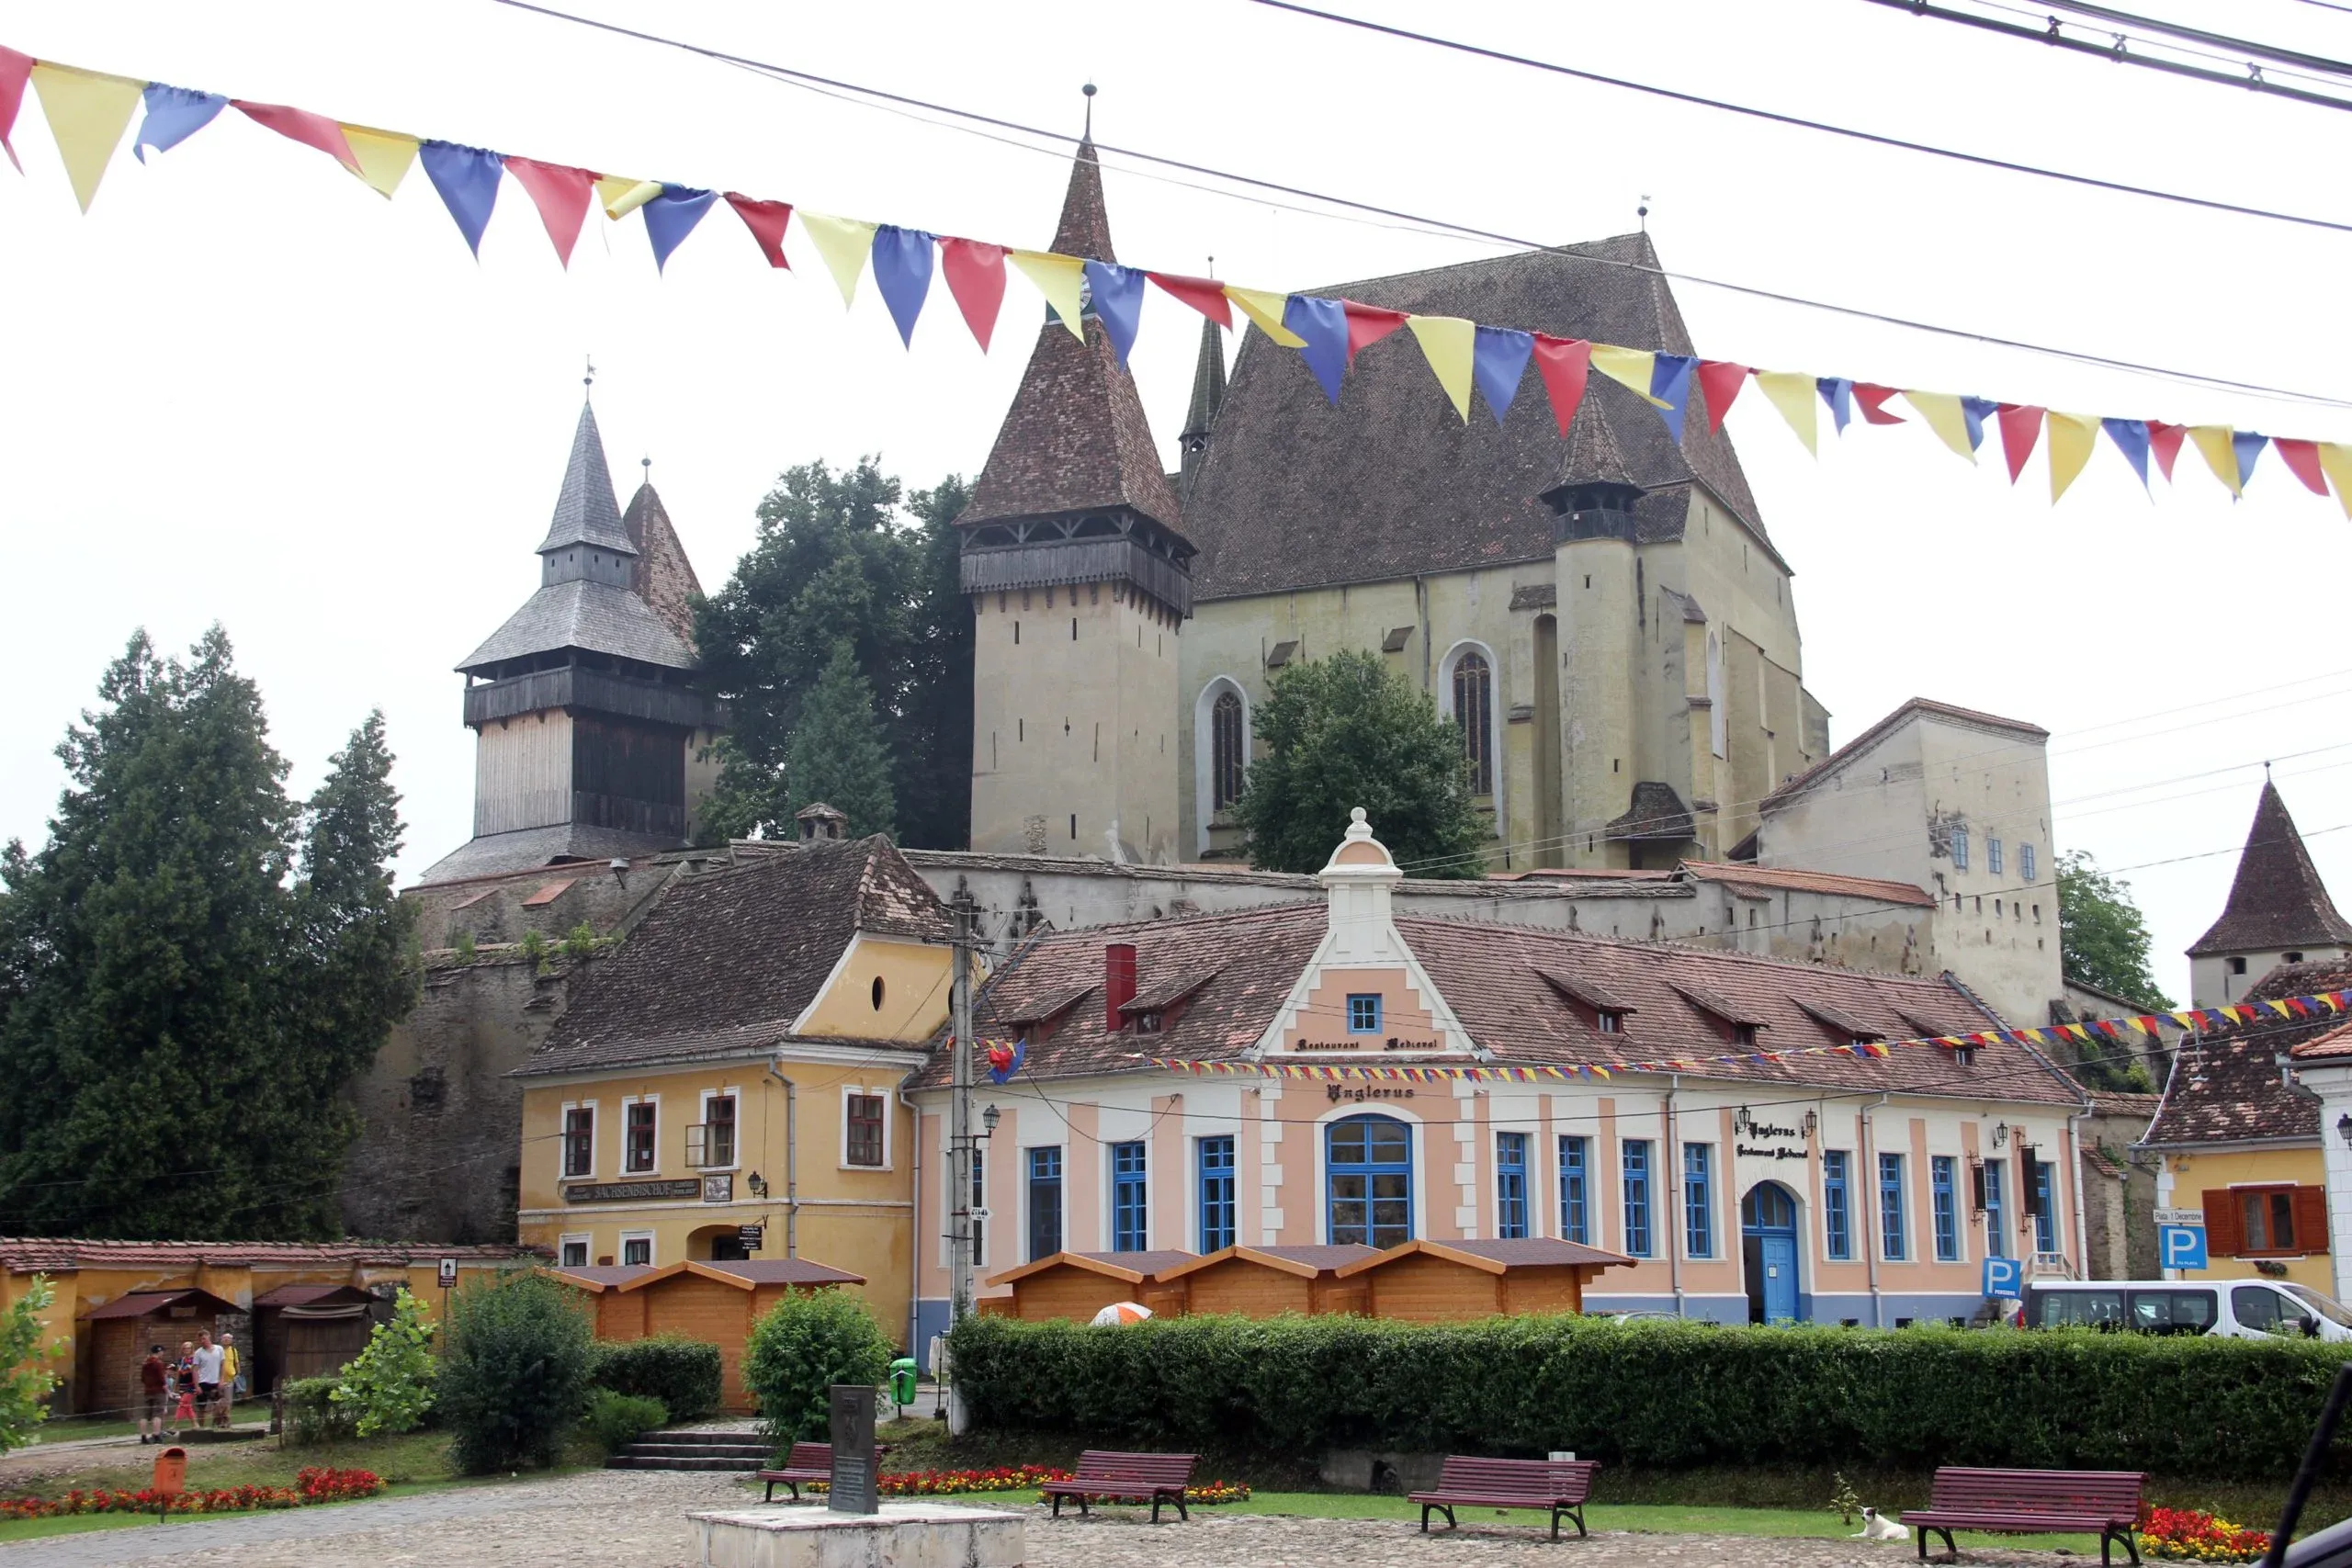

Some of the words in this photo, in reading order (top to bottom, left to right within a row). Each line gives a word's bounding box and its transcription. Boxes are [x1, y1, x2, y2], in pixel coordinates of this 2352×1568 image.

[1295, 1038, 1360, 1052] Restaurant
[1327, 1084, 1415, 1103] Unglerus
[2167, 1228, 2197, 1265] P
[1987, 1261, 2013, 1293] P
